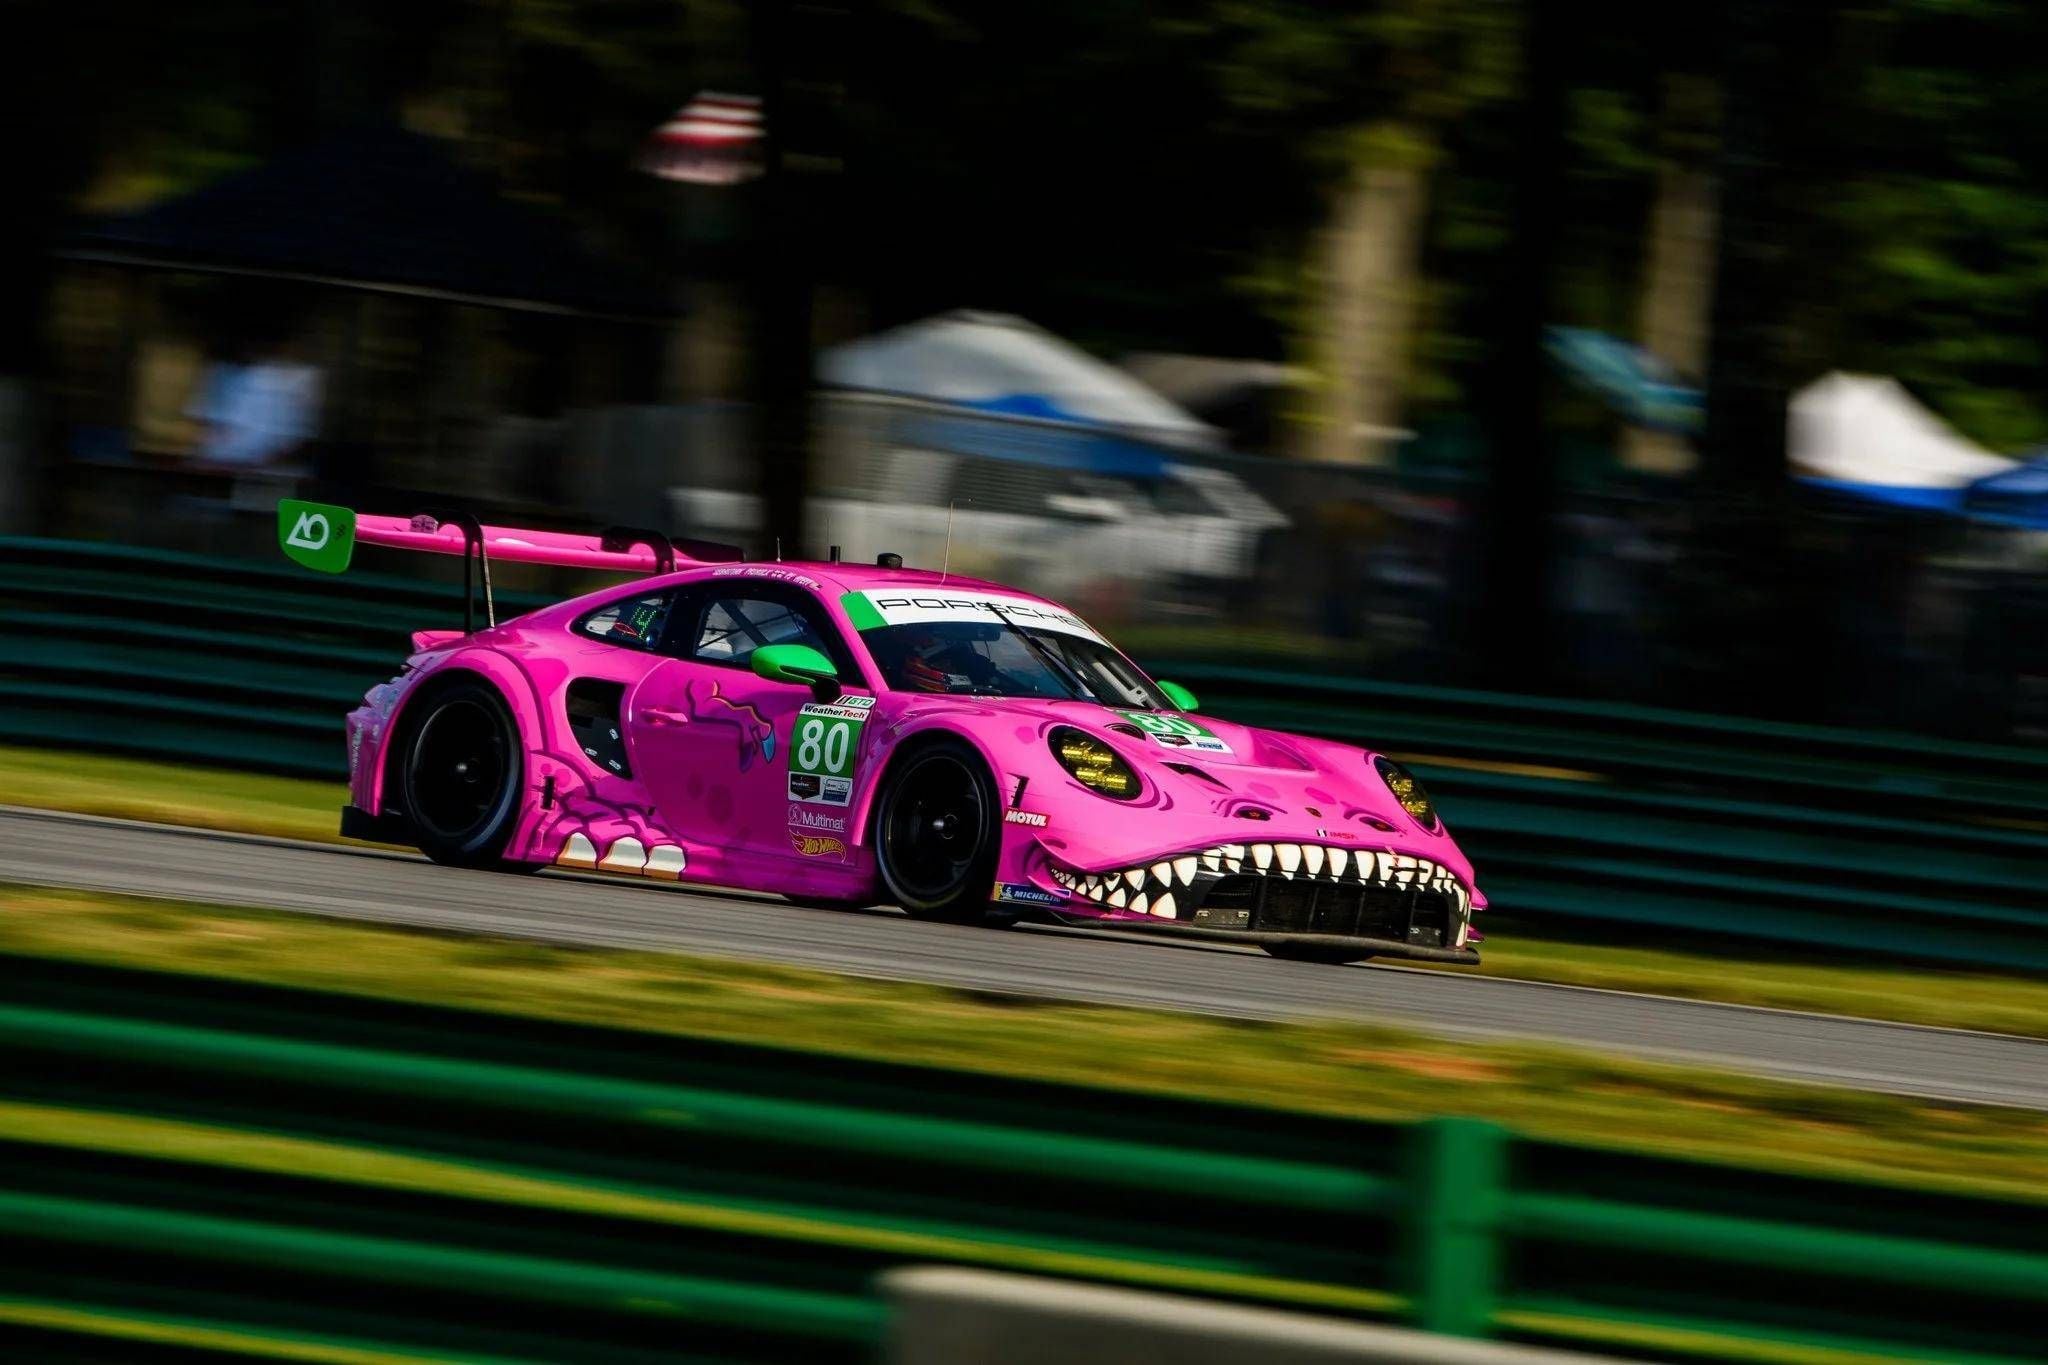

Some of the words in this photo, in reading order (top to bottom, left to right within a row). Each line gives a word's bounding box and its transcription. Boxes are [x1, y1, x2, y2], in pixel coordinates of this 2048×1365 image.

[876, 598, 1090, 631] PORSCHE
[804, 705, 866, 719] WeatherTech
[1128, 713, 1200, 735] 80
[798, 719, 850, 773] 80
[802, 811, 844, 830] Multimat
[1005, 810, 1047, 827] MOTUL
